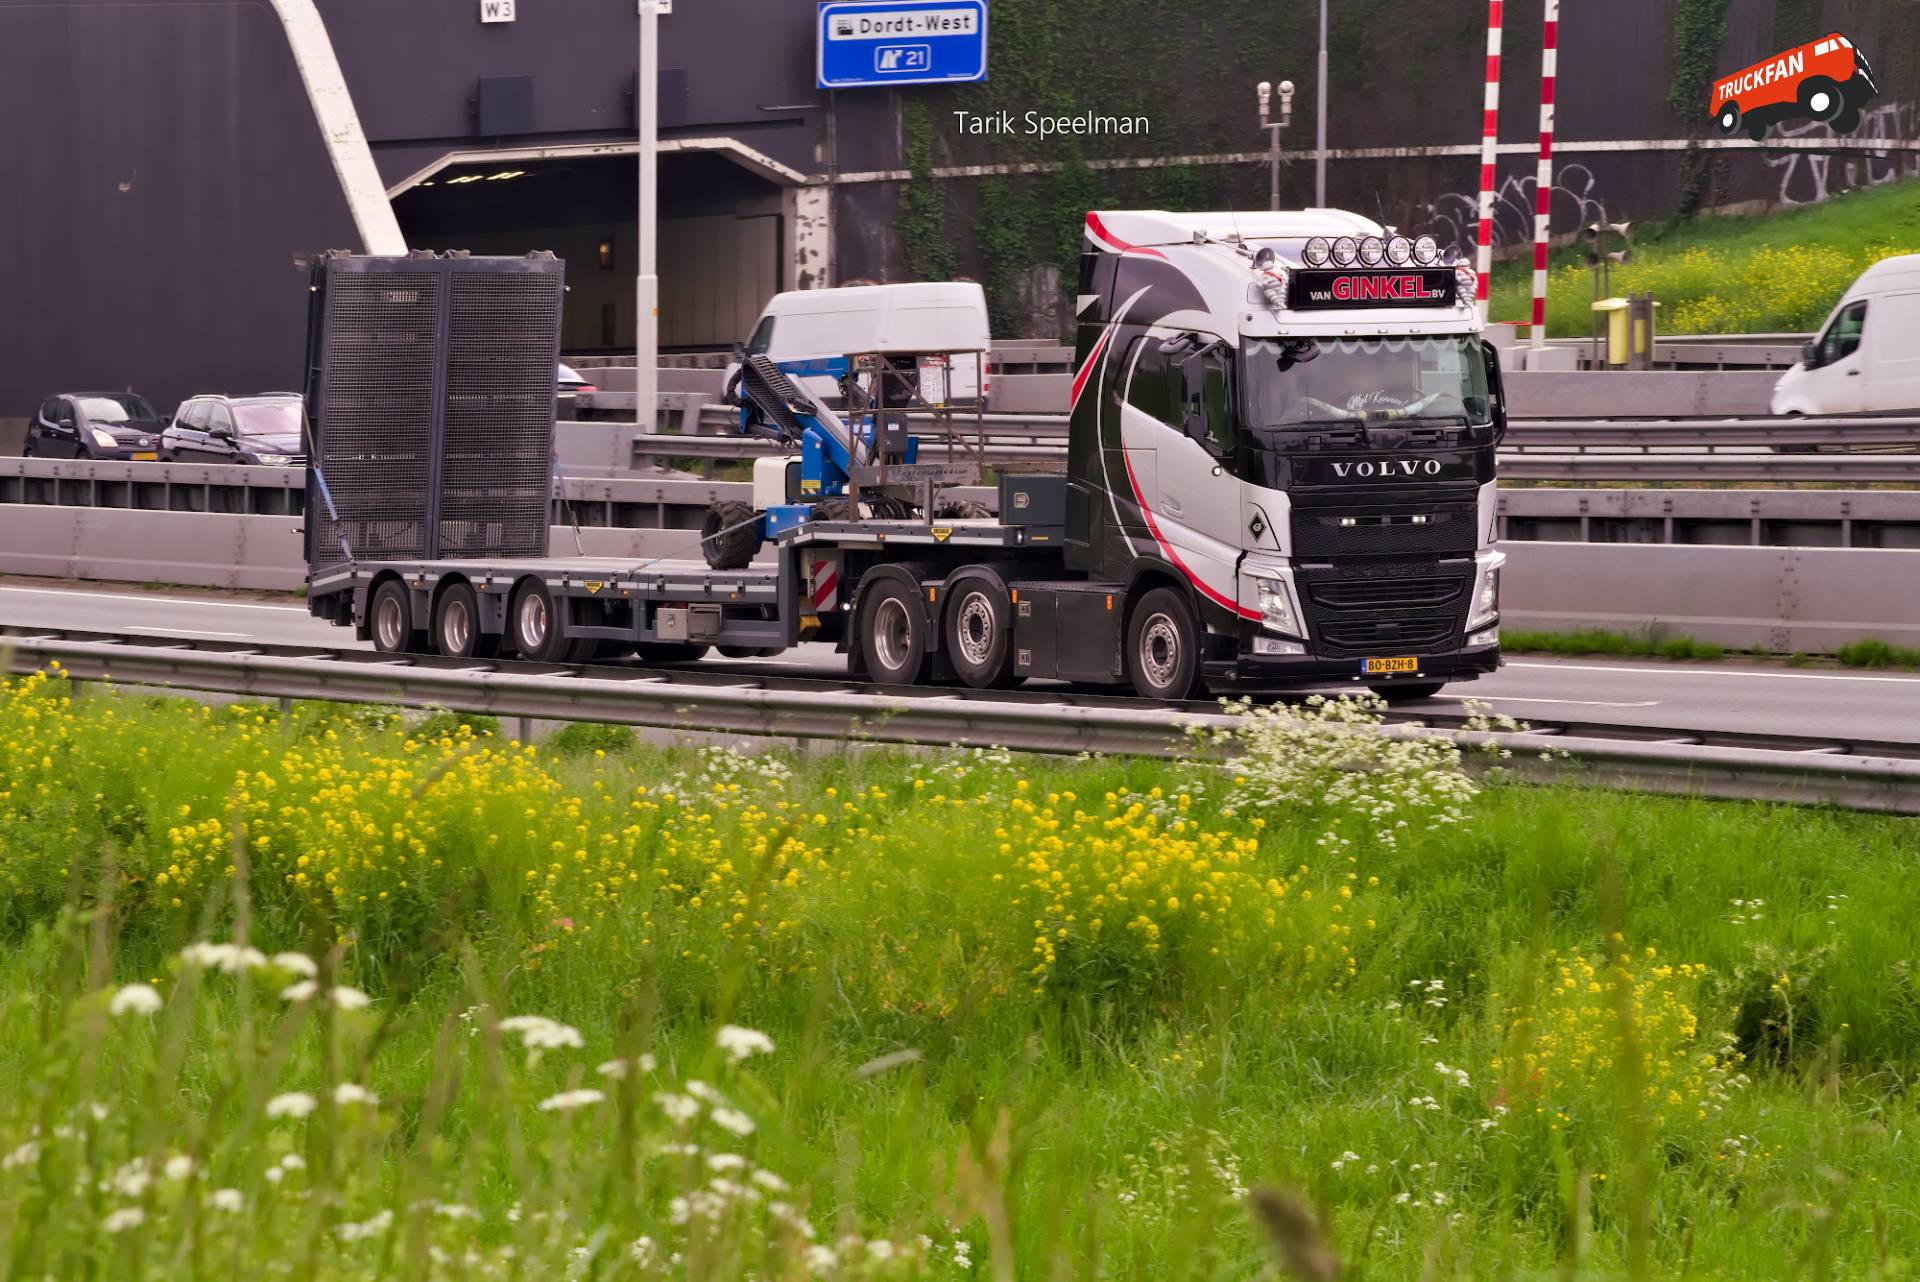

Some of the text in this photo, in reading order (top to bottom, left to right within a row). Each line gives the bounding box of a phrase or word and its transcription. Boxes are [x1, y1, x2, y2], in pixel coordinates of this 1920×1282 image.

[860, 14, 971, 34] Dordt-West
[905, 51, 925, 66] 21
[1310, 275, 1446, 301] VAN GINKEL BV
[1330, 459, 1441, 477] VOLVO
[1368, 658, 1414, 671] 80-BZH-8
